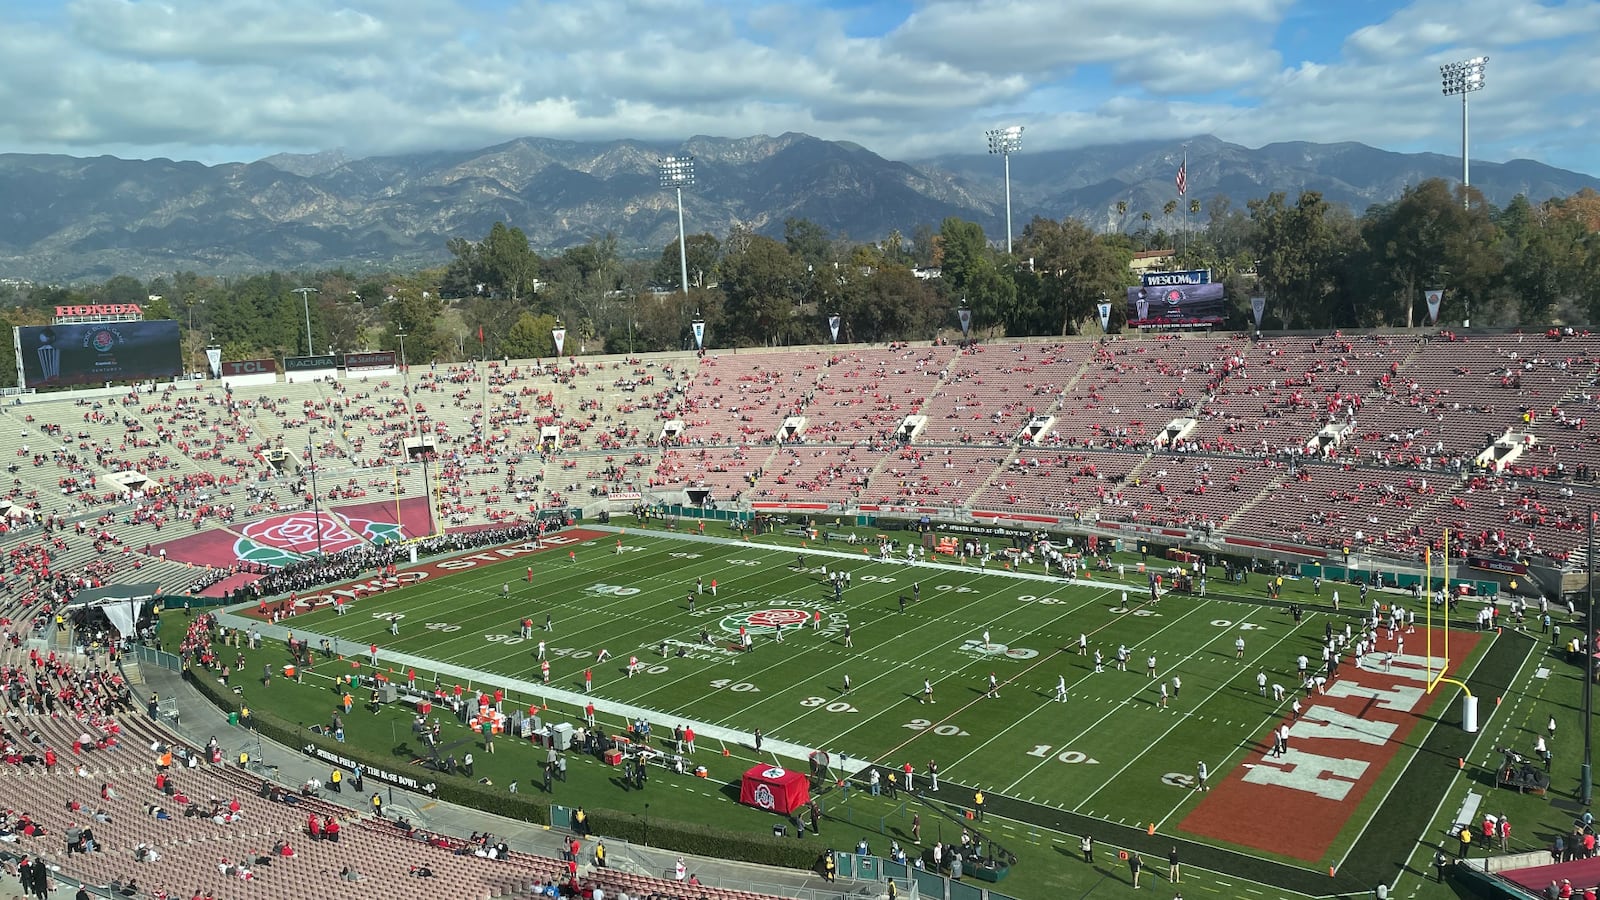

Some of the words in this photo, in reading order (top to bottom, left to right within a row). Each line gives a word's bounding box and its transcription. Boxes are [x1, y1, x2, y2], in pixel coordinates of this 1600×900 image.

[1148, 275, 1188, 286] WESCOM
[54, 303, 144, 317] HONDA
[231, 362, 267, 374] TCL
[296, 357, 334, 367] ACURA
[294, 571, 430, 607] OHIO
[436, 535, 580, 570] STATE
[486, 634, 525, 645] 30
[552, 647, 593, 659] 40
[709, 678, 754, 692] 40
[800, 696, 851, 713] 30
[902, 718, 960, 736] 20
[1241, 651, 1450, 802] UTAH
[1026, 744, 1087, 764] 10
[339, 756, 356, 769] FIELD
[366, 765, 380, 777] THE
[398, 776, 419, 789] BOWL
[1160, 772, 1196, 788] G
